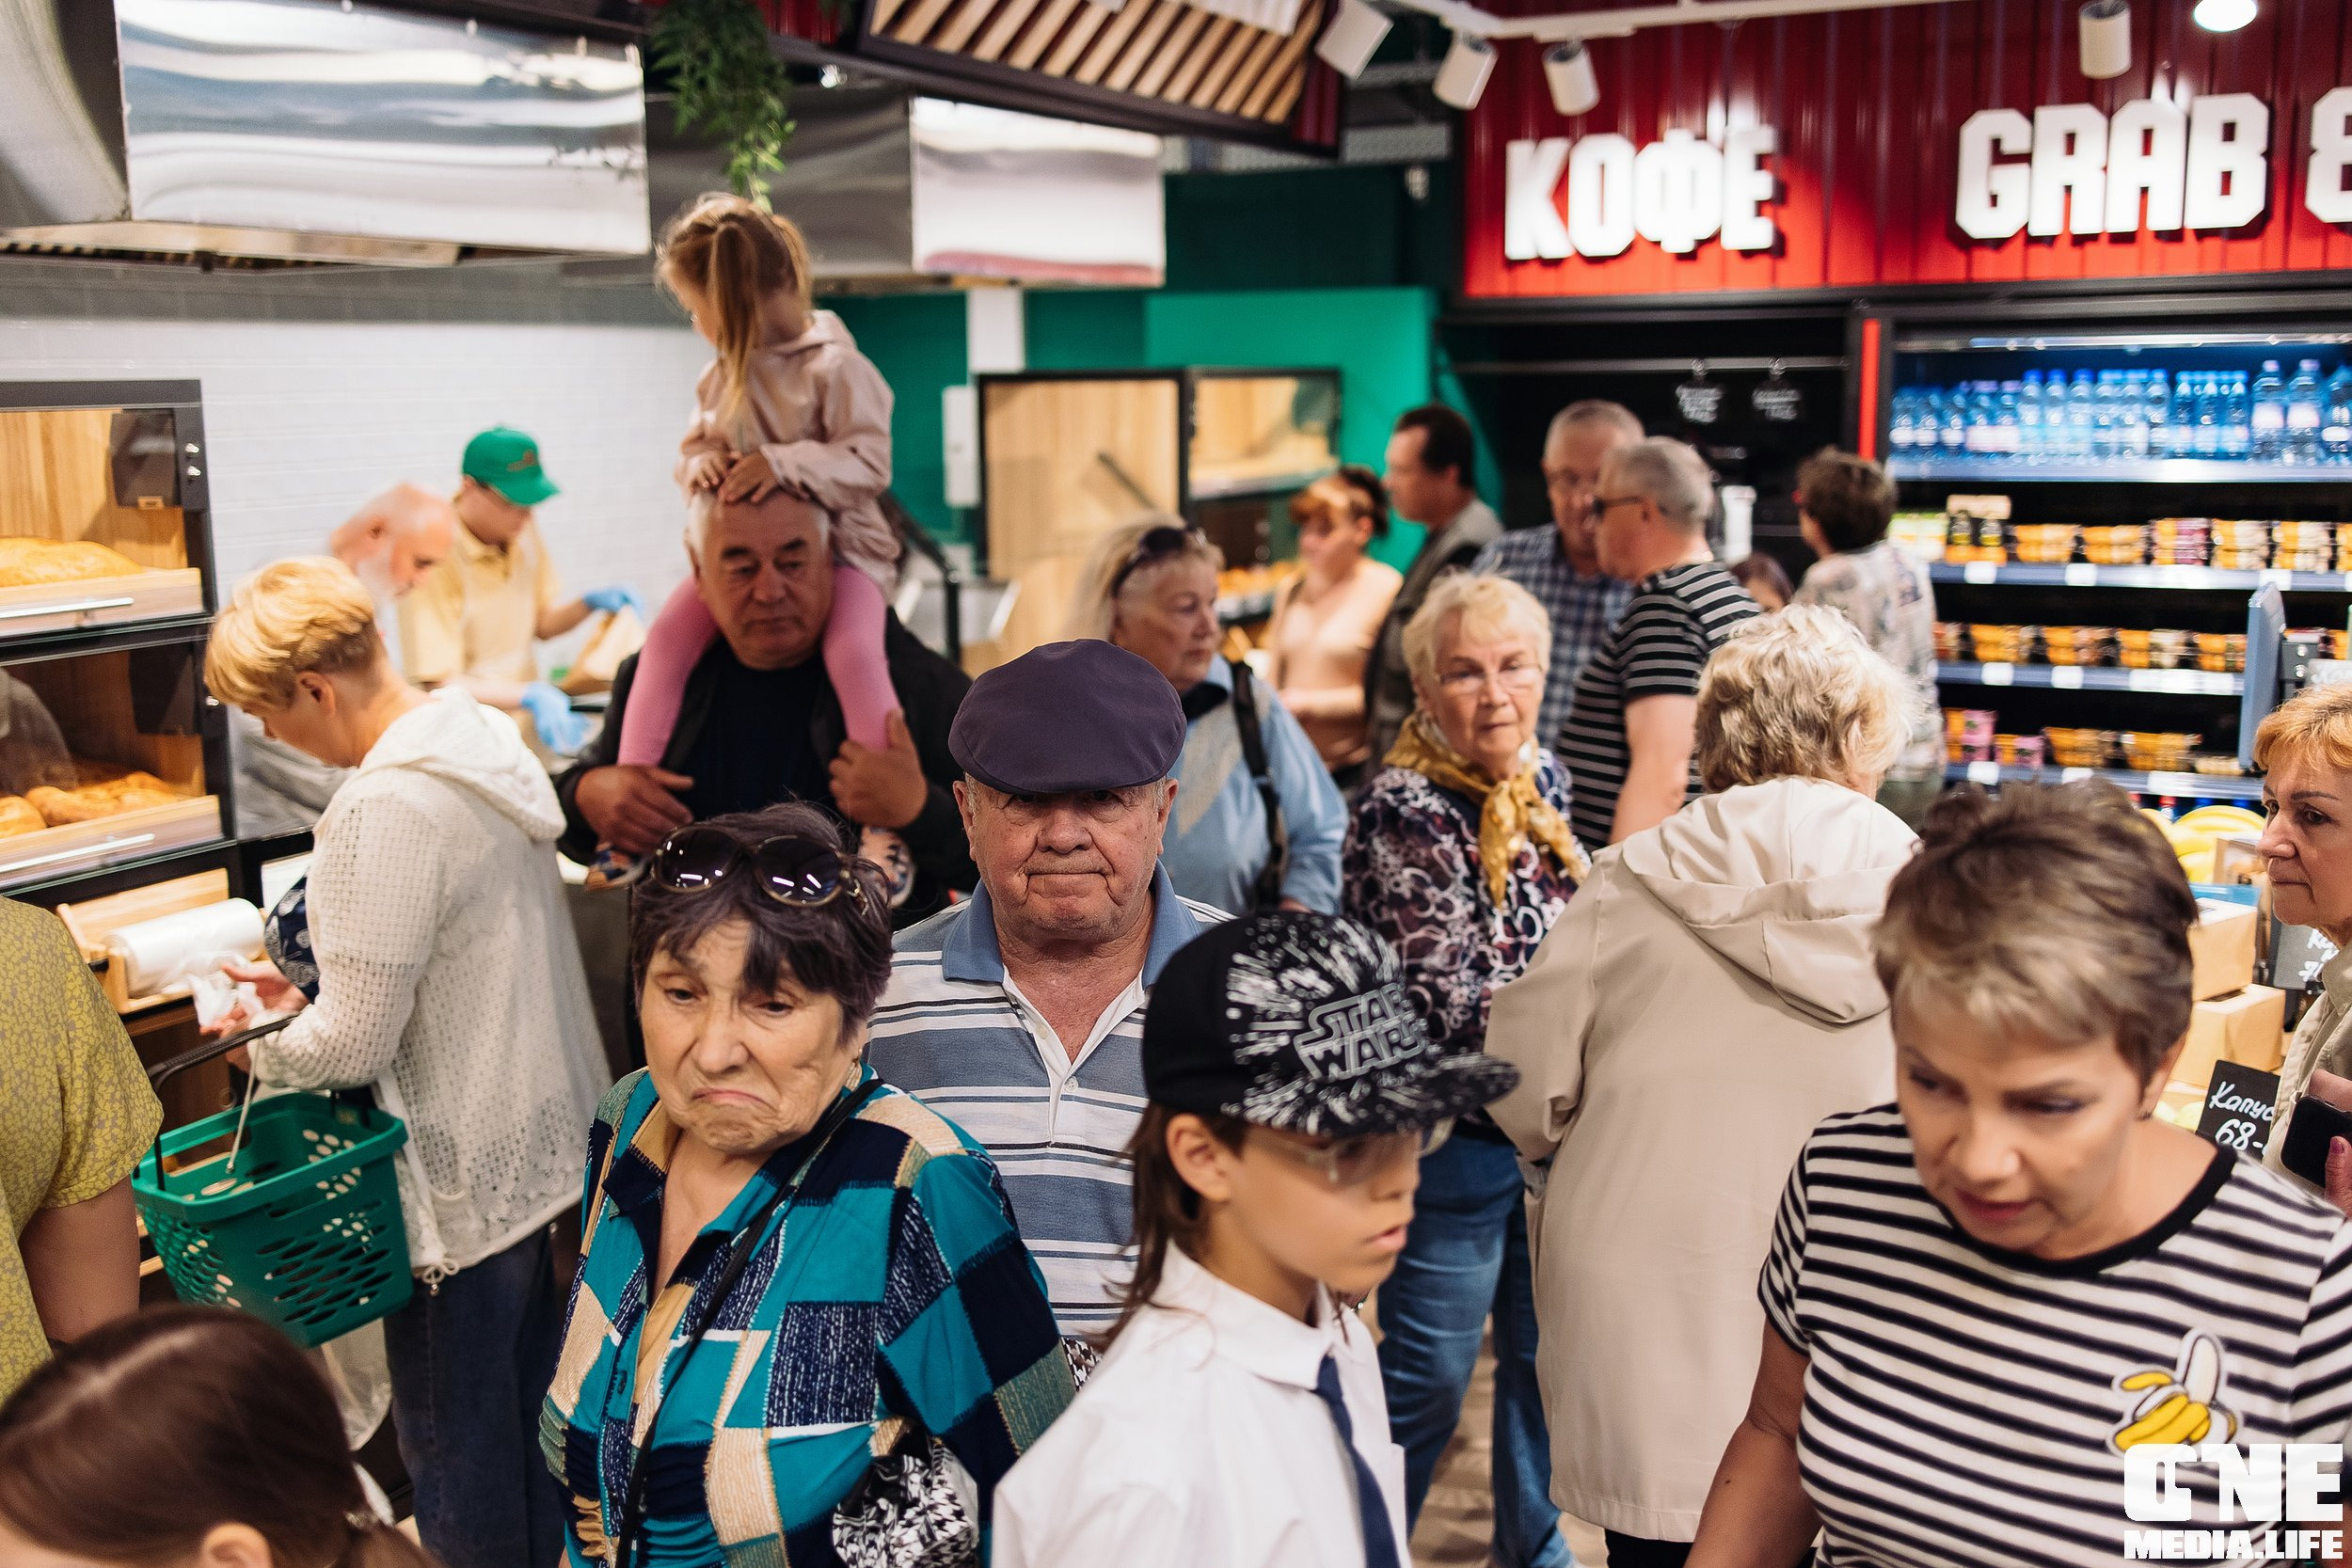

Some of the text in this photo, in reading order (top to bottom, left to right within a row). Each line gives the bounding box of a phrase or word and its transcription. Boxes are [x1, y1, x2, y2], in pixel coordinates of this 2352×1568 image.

[1504, 125, 1776, 261] КОФЕ
[1955, 92, 2270, 239] GRAB
[2215, 1118, 2268, 1156] 68-
